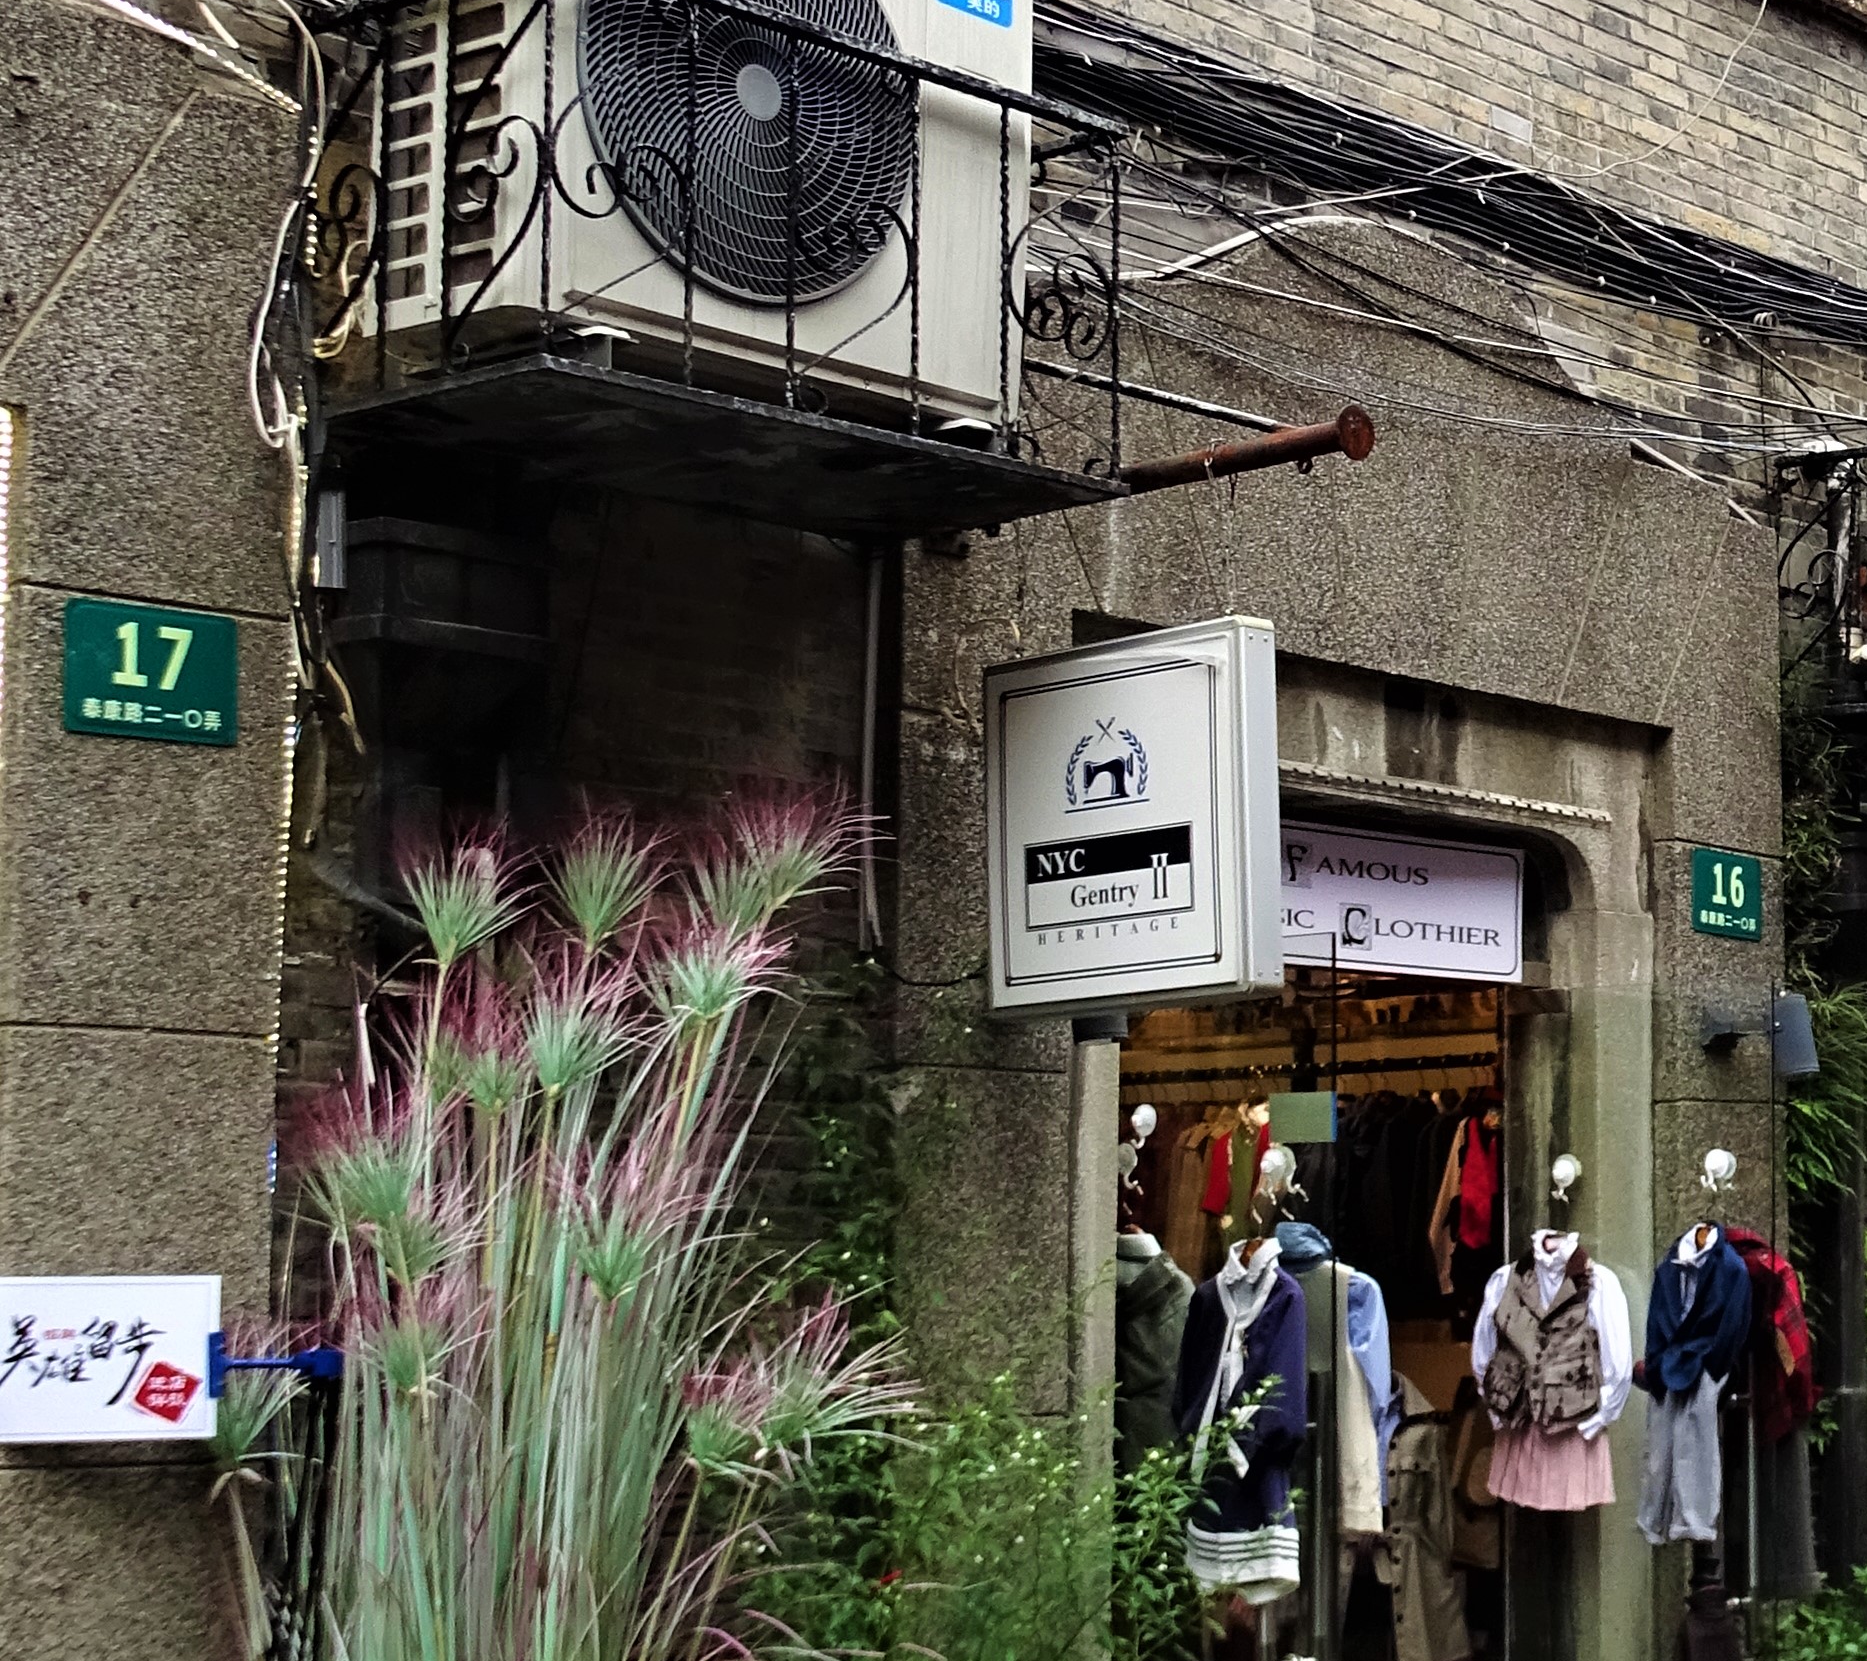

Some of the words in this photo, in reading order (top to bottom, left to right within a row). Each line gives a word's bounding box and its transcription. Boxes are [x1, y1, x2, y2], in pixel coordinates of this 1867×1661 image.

[111, 621, 194, 691] 17
[1036, 848, 1086, 877] NYC
[1286, 843, 1429, 886] FAMOUS
[1071, 882, 1139, 908] Gentry
[1712, 862, 1745, 908] 16
[1037, 916, 1179, 946] HERITAGE
[1281, 907, 1315, 930] IC
[1341, 906, 1502, 948] CLOTHIER
